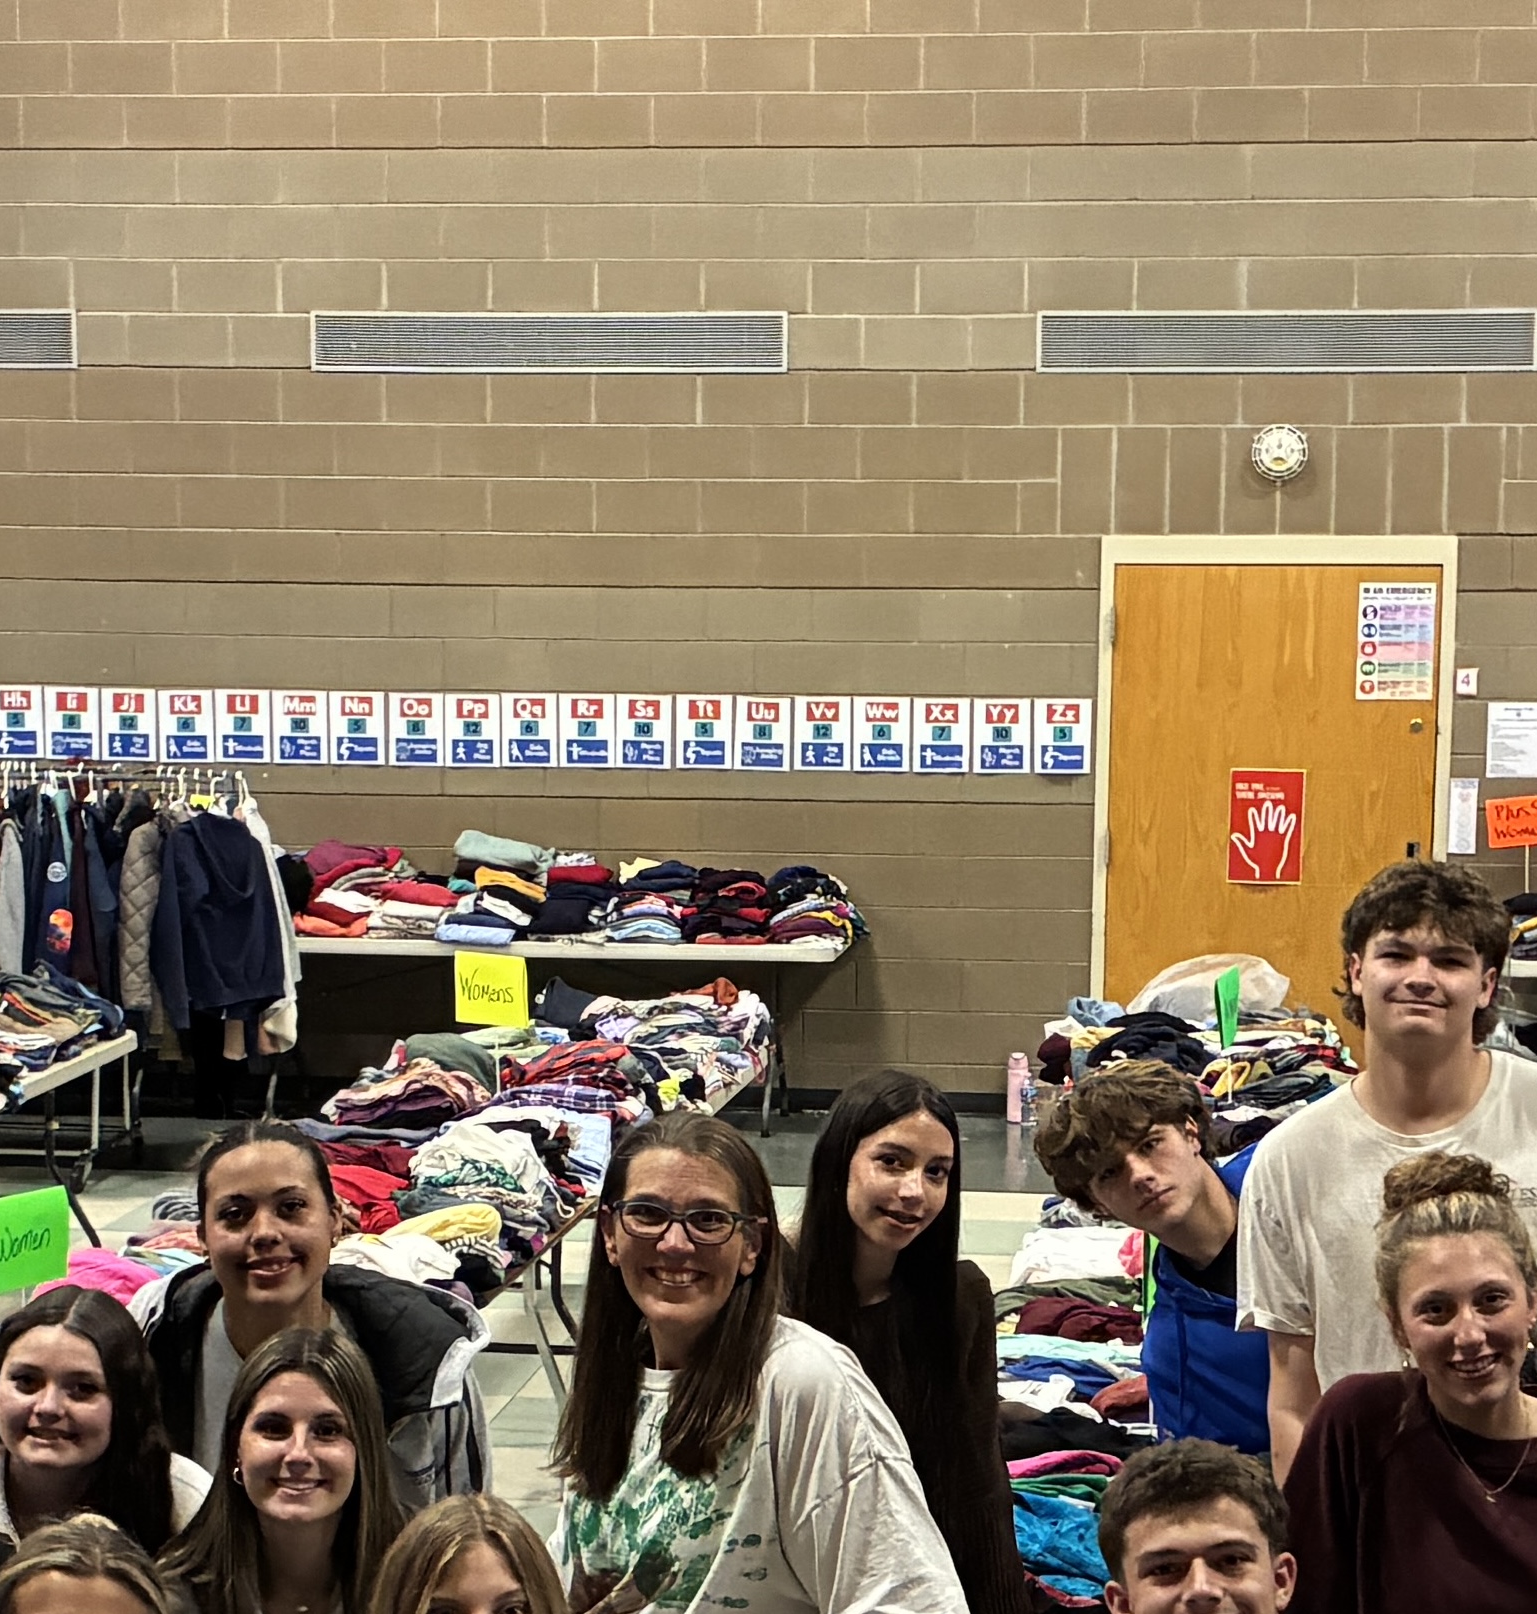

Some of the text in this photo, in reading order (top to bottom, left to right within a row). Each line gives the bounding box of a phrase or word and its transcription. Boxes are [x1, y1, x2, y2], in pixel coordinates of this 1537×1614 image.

[4, 692, 27, 707] Hh
[120, 694, 135, 711] Jj
[174, 696, 197, 711] Kk
[284, 697, 315, 712] Mm
[345, 698, 368, 713] Nn
[404, 699, 428, 715] Oo
[463, 700, 484, 717] Pp
[578, 701, 598, 715] Rr
[635, 701, 654, 717] Ss
[696, 702, 713, 717] Tt
[752, 704, 775, 720] Uu
[812, 704, 834, 718] Vv
[867, 705, 897, 718] Ww
[930, 705, 954, 720] Xx
[991, 706, 1014, 722] Yy
[1052, 706, 1075, 721] Zz
